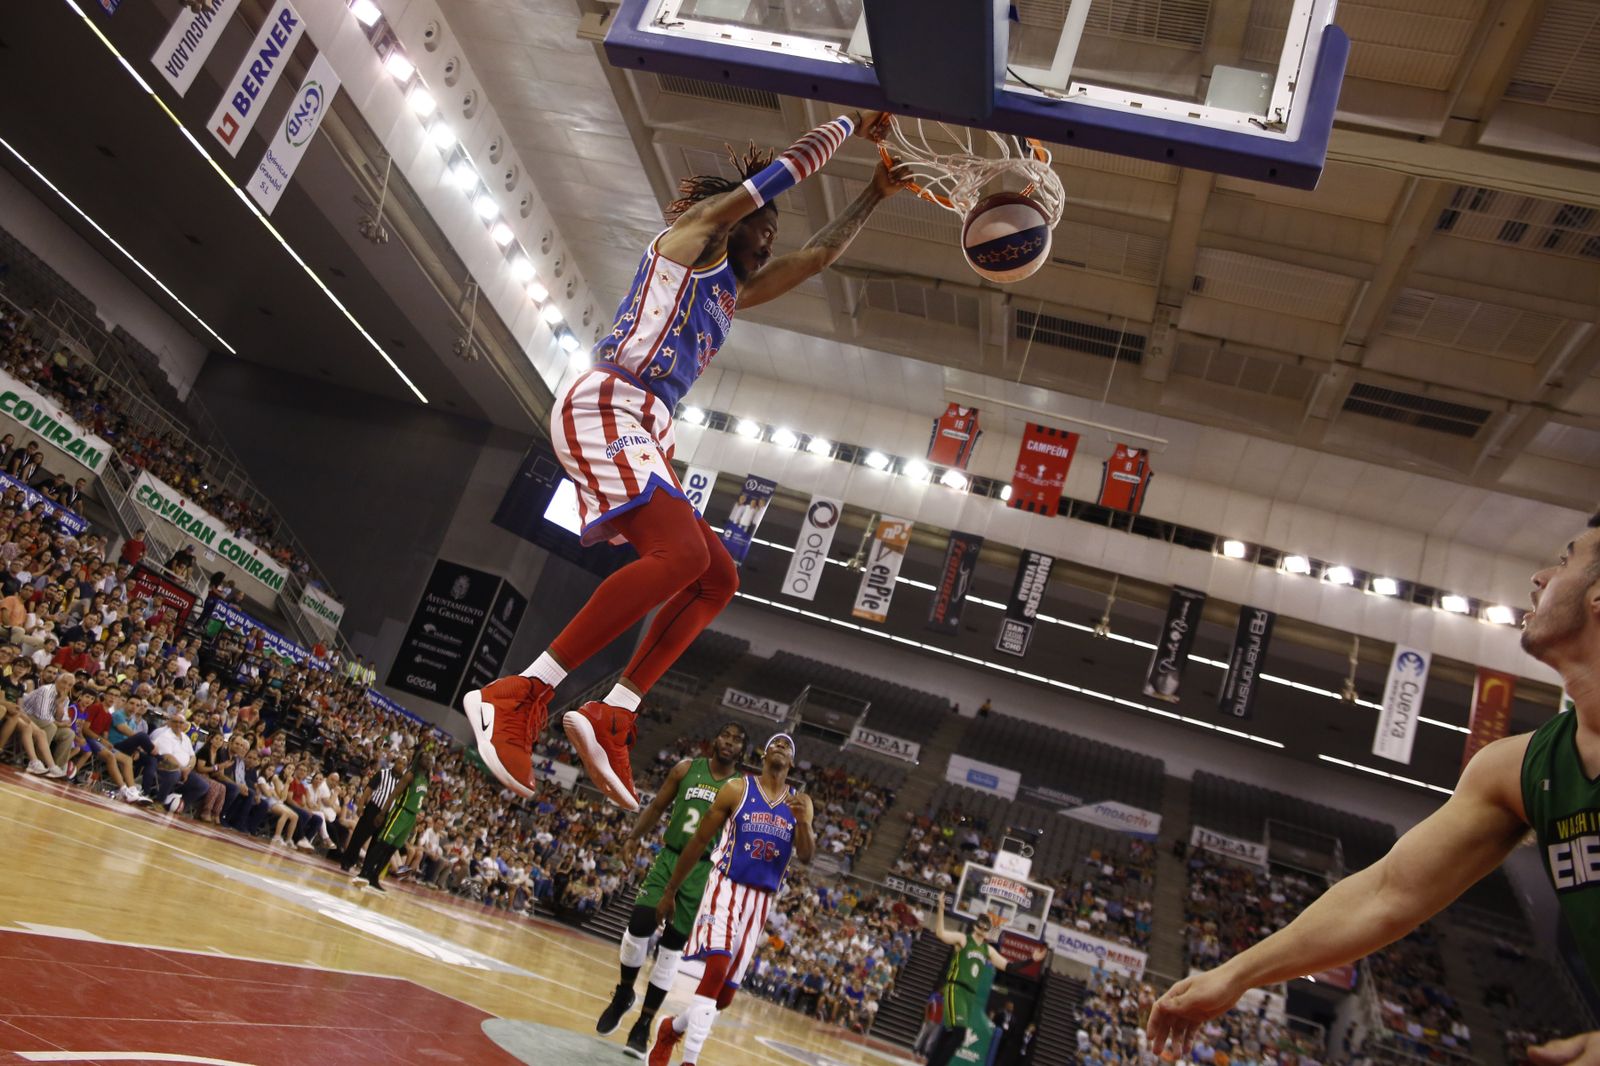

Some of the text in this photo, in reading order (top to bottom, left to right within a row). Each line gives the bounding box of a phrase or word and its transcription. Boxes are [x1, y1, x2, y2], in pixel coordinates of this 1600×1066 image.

[232, 8, 298, 118] BERNER
[288, 88, 319, 136] GNB
[0, 391, 103, 470] COVIRAN
[1026, 439, 1069, 458] CAMPEÓN
[136, 485, 284, 591] COVIRAN COVIRAN
[793, 533, 825, 594] otero
[1018, 564, 1036, 602] VERDAD
[1024, 555, 1053, 618] BURGERS
[303, 595, 340, 624] COVIRAN
[426, 593, 484, 617] AYUNTAMIENTO
[426, 605, 475, 625] DE GRANADA
[729, 692, 783, 718] IDEAL
[1391, 681, 1419, 739] Cuerva
[857, 729, 915, 757] IDEAL
[683, 807, 700, 834] 2
[752, 812, 788, 830] HARLEM
[1199, 831, 1260, 860] IDEAL
[1058, 934, 1094, 953] RADIO
